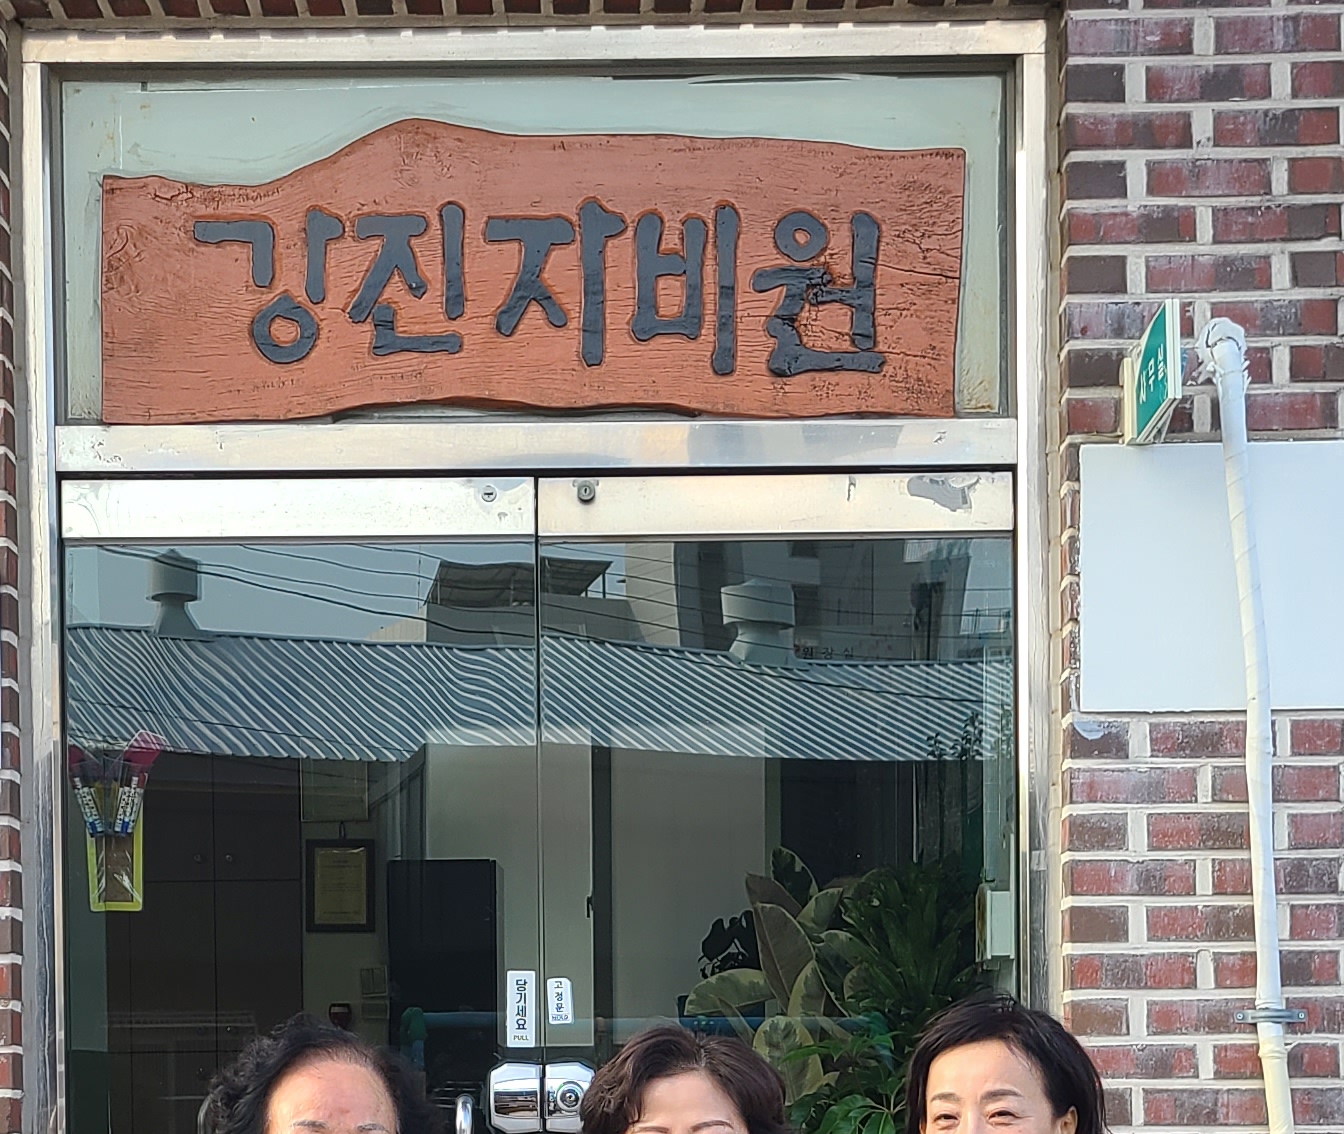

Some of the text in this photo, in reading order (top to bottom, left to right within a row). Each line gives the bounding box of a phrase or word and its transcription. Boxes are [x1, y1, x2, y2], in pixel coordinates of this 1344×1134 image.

[193, 196, 887, 378] 강진자비원
[514, 978, 528, 1031] 당기세요
[554, 980, 565, 1013] 고정문
